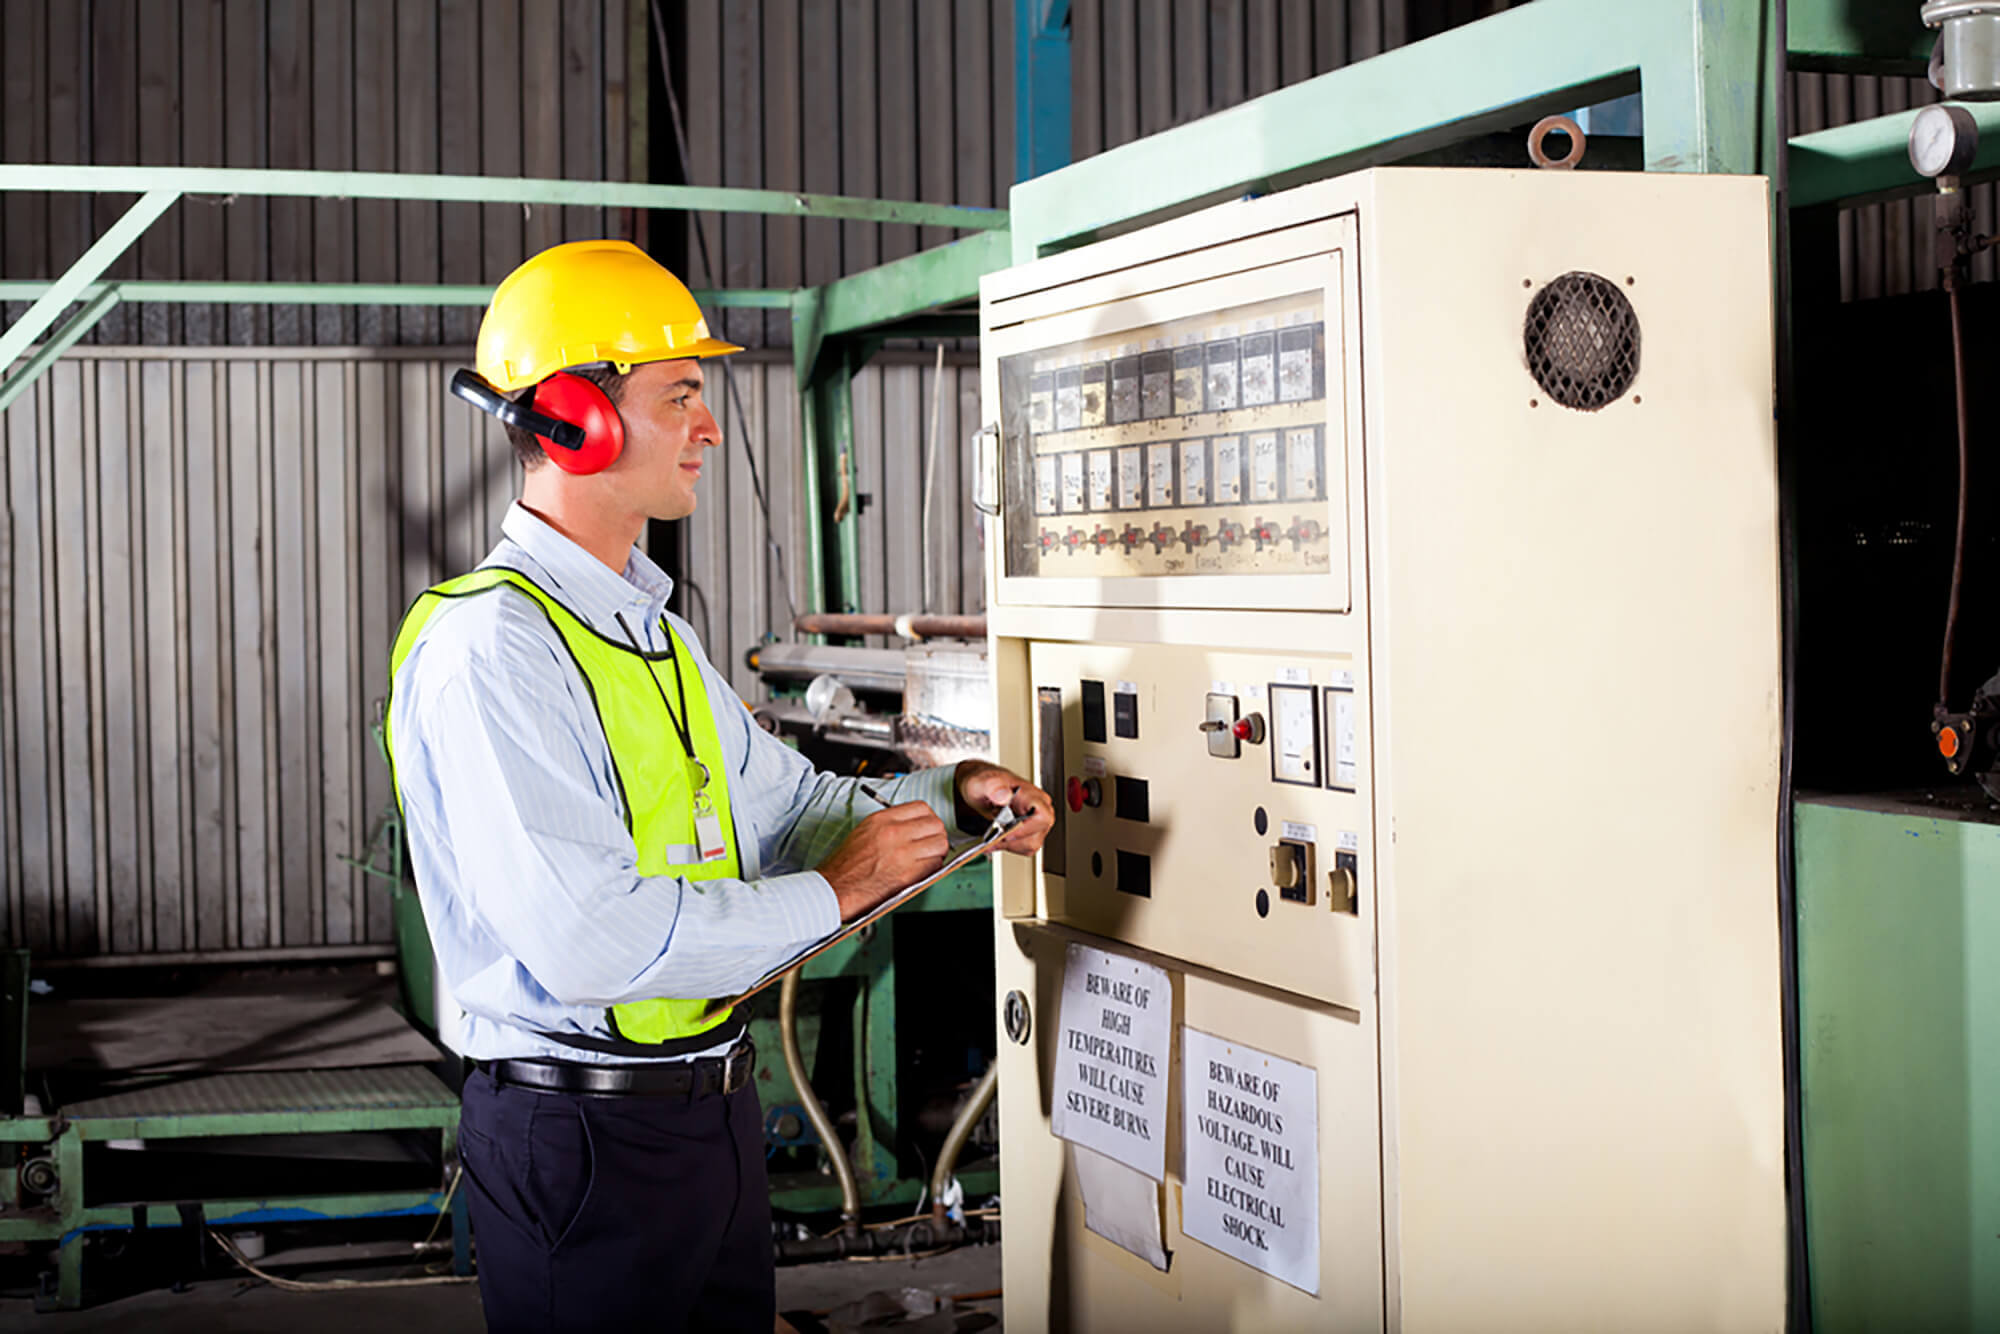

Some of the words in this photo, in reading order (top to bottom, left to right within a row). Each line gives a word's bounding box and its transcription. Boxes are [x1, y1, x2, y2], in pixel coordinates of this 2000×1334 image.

[1086, 973, 1132, 1005] BEWARE
[1135, 987, 1150, 1009] OF
[1101, 1008, 1131, 1036] HIGH
[1079, 1062, 1107, 1091] WILL
[1109, 1074, 1144, 1105] CAUSE
[1209, 1060, 1261, 1096] BEWARE
[1263, 1079, 1280, 1103] OF
[1066, 1089, 1111, 1124] SEVERE
[1207, 1089, 1283, 1135] HAZARDOUS
[1225, 1155, 1265, 1189] CAUSE
[1260, 1138, 1294, 1170] WILL
[1207, 1177, 1285, 1228] ELECTRICAL
